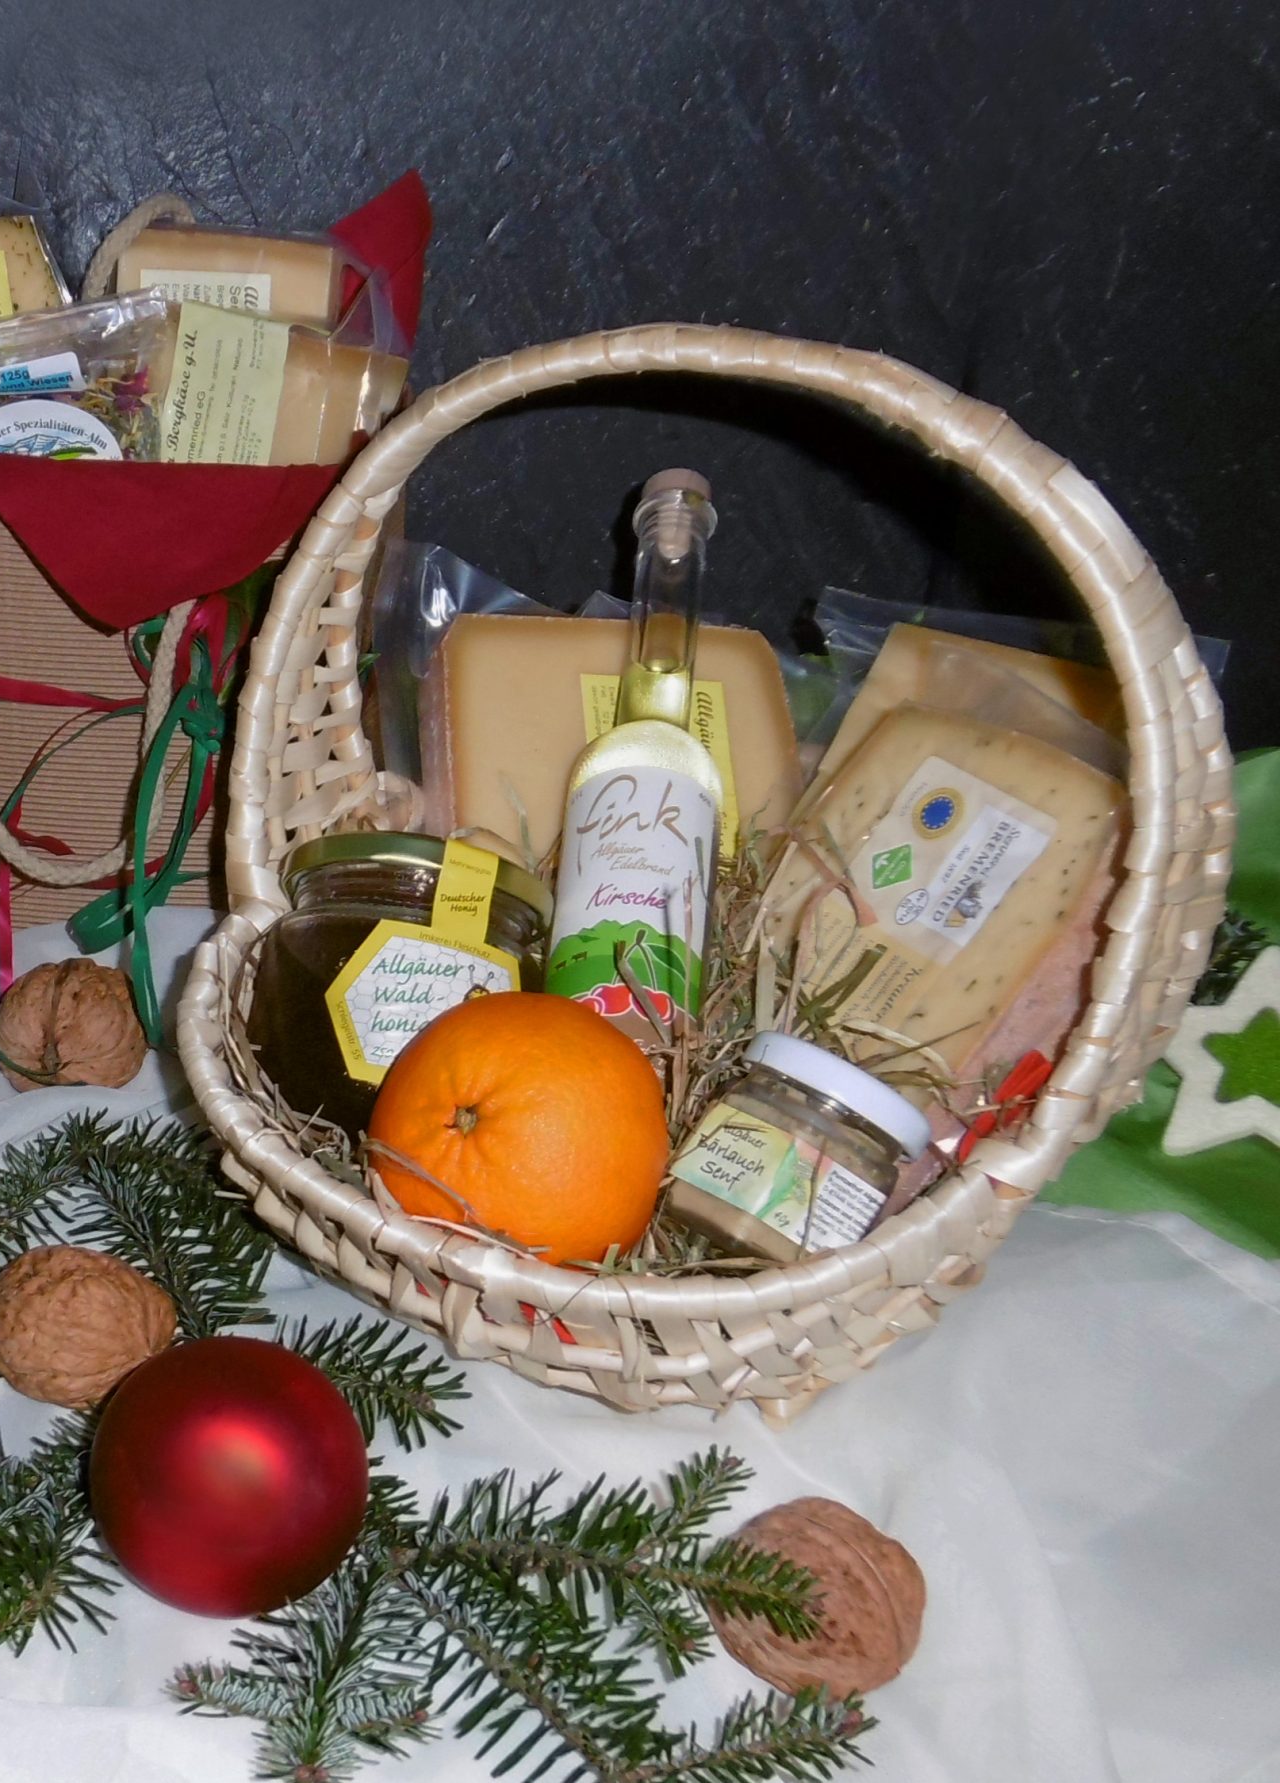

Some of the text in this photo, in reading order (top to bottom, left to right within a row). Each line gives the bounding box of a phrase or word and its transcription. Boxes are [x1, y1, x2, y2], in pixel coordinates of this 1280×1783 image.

[0, 368, 31, 382] 125g
[28, 373, 74, 387] Wiesen
[166, 371, 191, 452] Bergkäse
[188, 391, 206, 463] menried eG
[591, 842, 645, 861] Allgäuer
[609, 855, 675, 876] Edelbrand
[932, 821, 1010, 922] BREMENRIED
[440, 893, 487, 903] Deutscher
[586, 882, 667, 911] Kirsche
[450, 903, 478, 916] Honig
[419, 931, 453, 948] Imkerei
[372, 954, 463, 984] Allgäuer
[374, 984, 445, 1004] Wald-
